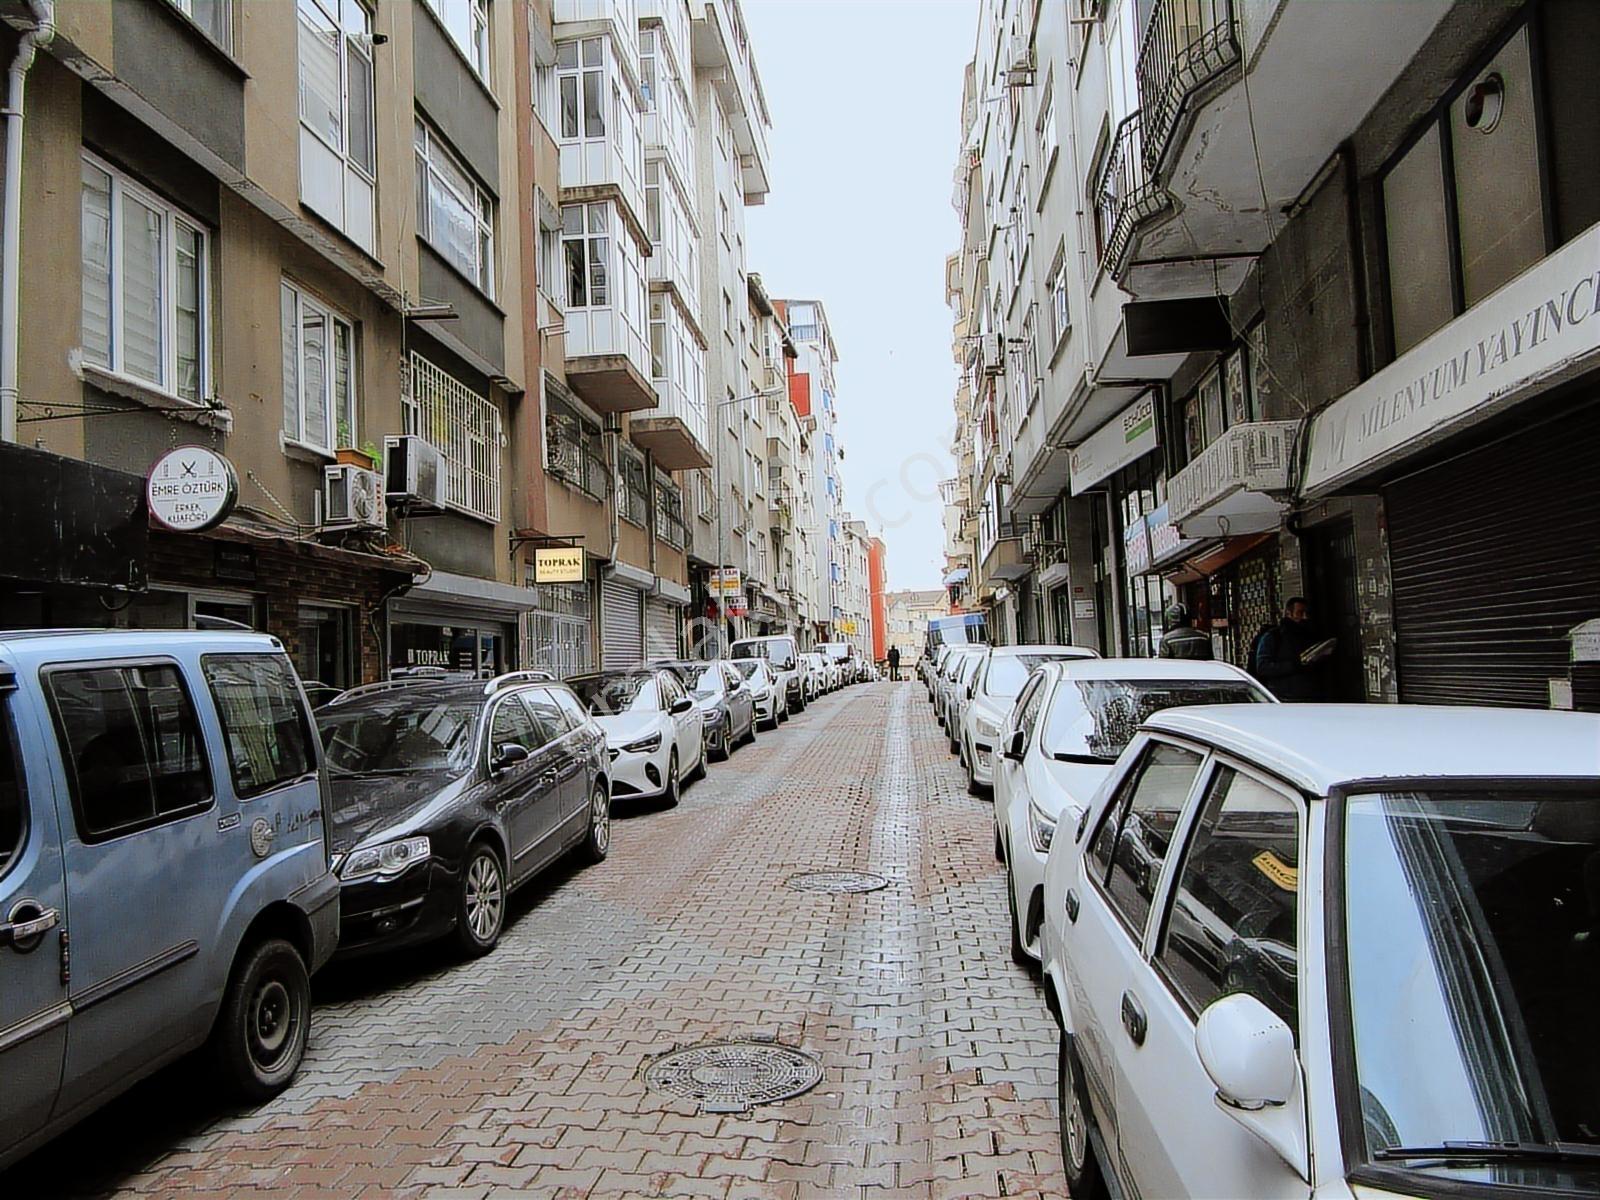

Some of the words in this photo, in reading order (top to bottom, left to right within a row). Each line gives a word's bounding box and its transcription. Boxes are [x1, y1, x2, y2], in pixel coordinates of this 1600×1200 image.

[1358, 348, 1472, 442] MİLENYUM
[152, 484, 179, 497] EMRE
[181, 480, 224, 495] ÖZTÜRK
[538, 558, 580, 567] TOPRAK
[416, 649, 450, 665] TOPRAK
